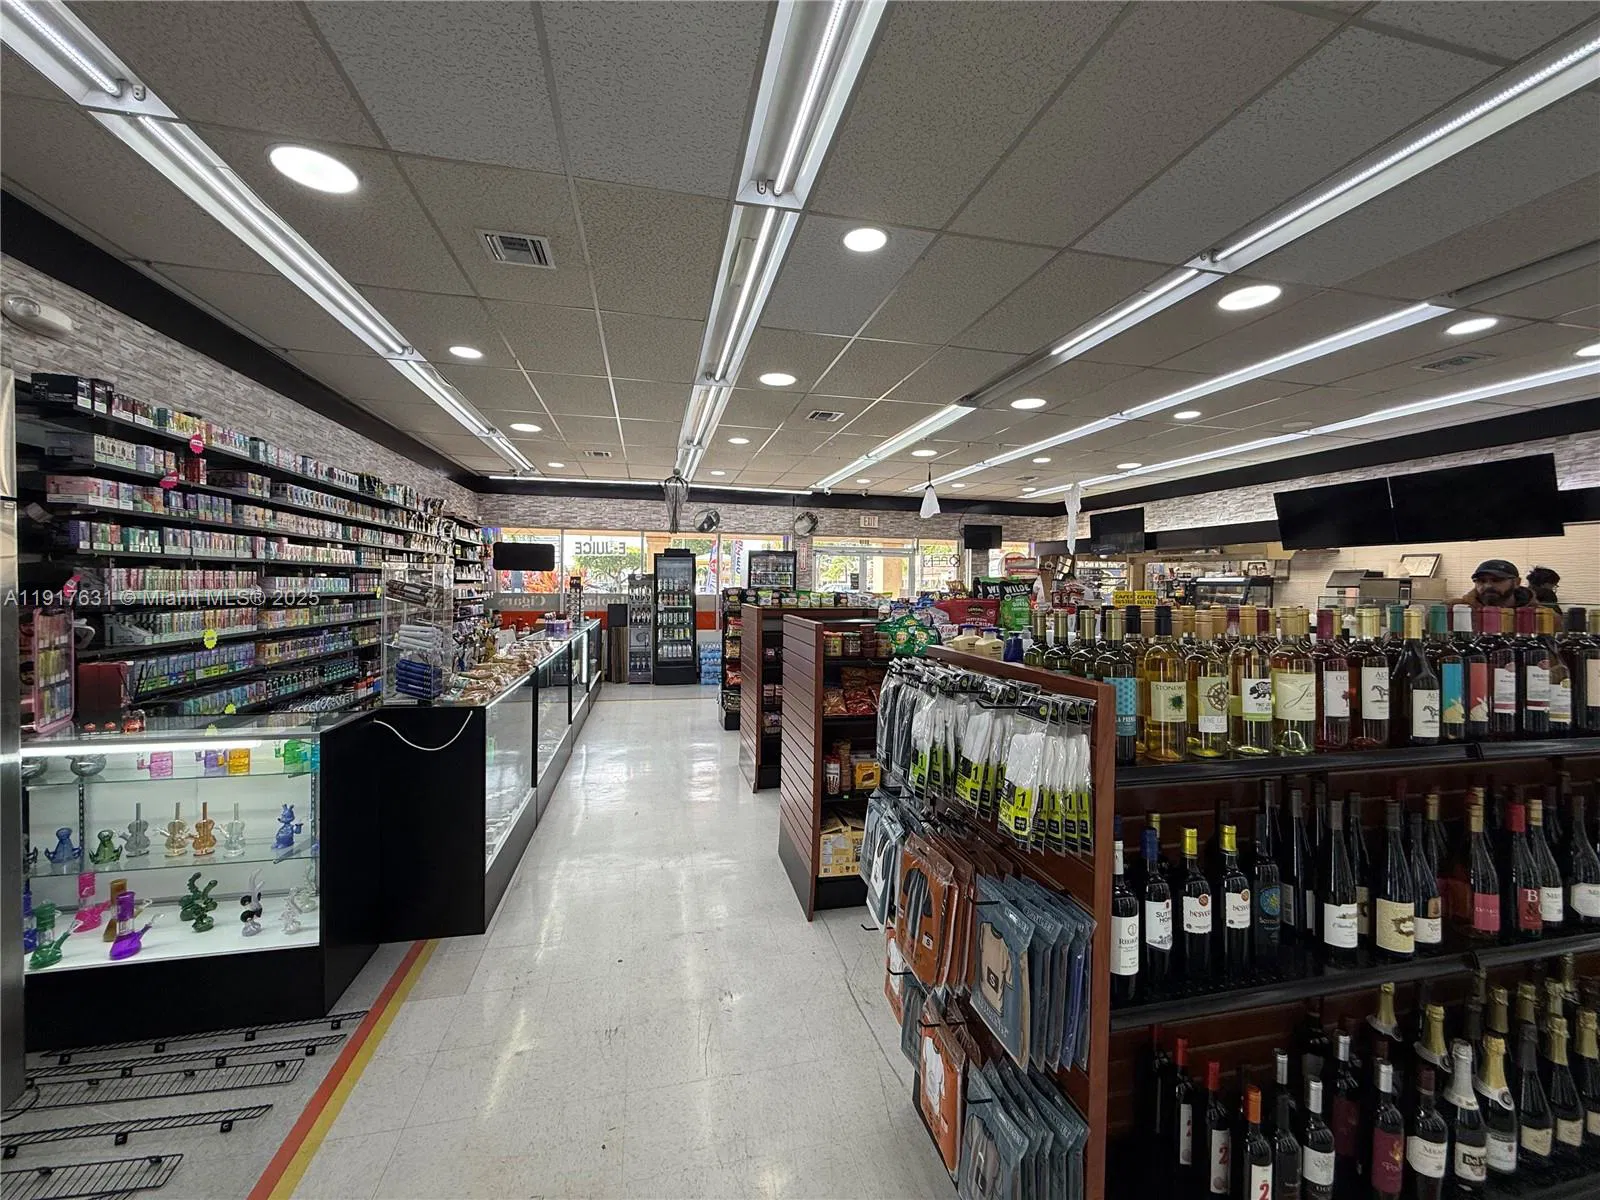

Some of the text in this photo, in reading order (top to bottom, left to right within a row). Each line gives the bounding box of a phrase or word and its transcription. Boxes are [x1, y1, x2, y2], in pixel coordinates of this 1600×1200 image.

[1004, 584, 1031, 594] WILDE
[1018, 791, 1026, 807] 1
[1259, 1184, 1269, 1200] 2
